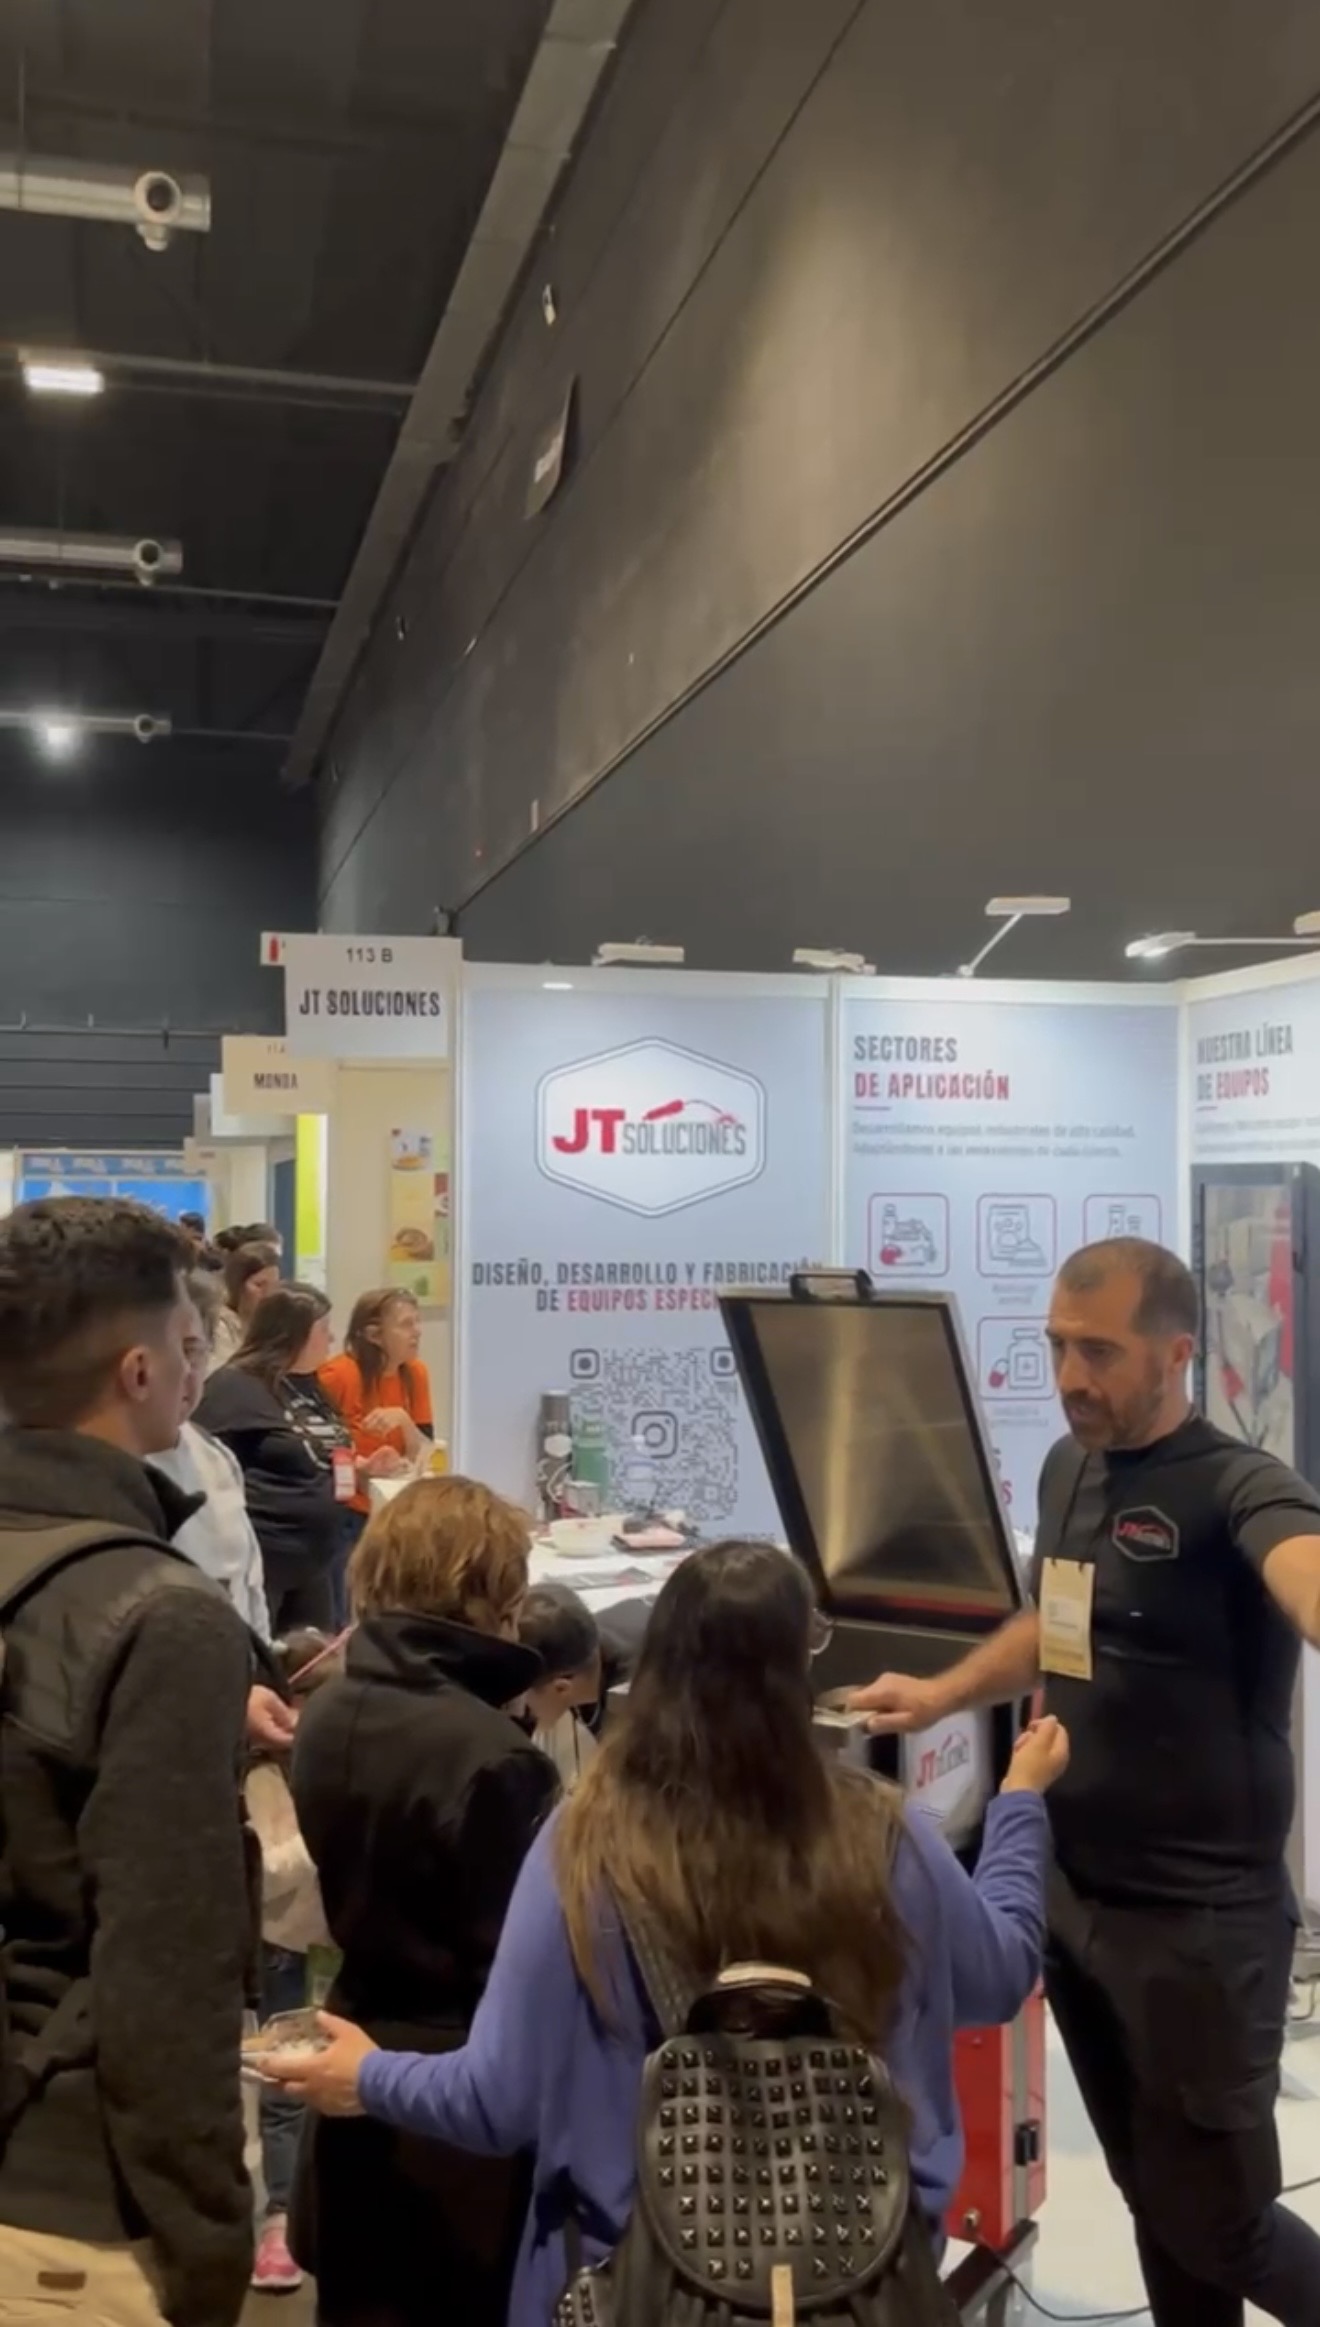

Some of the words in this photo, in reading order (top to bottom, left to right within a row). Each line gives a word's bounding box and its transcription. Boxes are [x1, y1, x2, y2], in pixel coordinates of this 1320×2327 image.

[347, 948, 375, 963] 113
[381, 948, 393, 963] B
[300, 990, 320, 1015] JT
[327, 990, 440, 1016] SOLUCIONES
[854, 1035, 957, 1062] SECTORES
[855, 1073, 879, 1098] DE
[887, 1068, 1009, 1100] APLICACIÓN
[1197, 1073, 1213, 1101] DE
[1216, 1066, 1269, 1099] EQUIPOS
[552, 1108, 626, 1154] JT
[622, 1122, 747, 1155] SOLUCIONES
[472, 1257, 549, 1287] DISEÑO,
[557, 1262, 677, 1285] DESARROLLO
[685, 1262, 696, 1285] Y
[536, 1289, 559, 1312] DE
[567, 1288, 647, 1312] EQUIPOS
